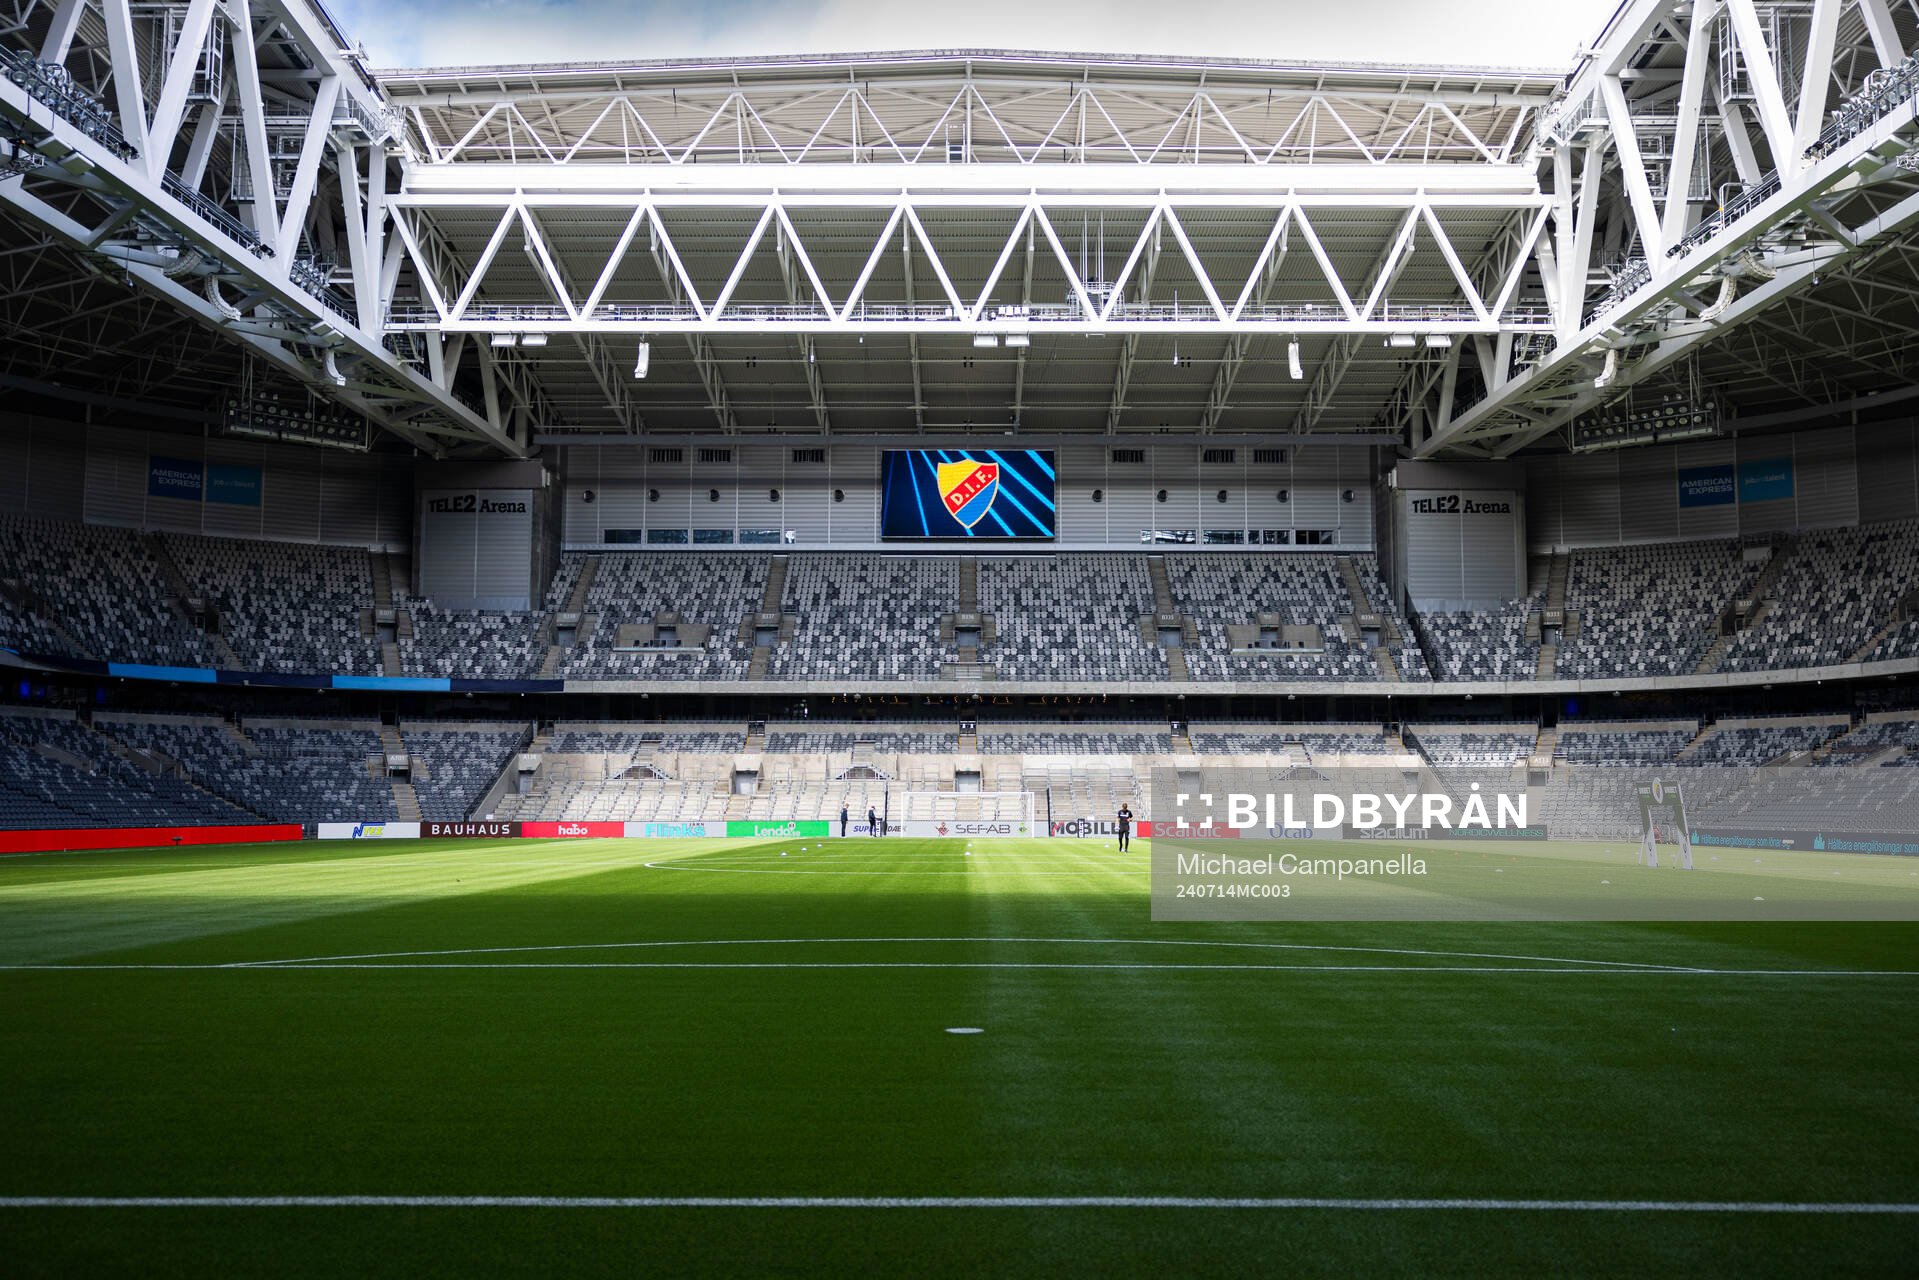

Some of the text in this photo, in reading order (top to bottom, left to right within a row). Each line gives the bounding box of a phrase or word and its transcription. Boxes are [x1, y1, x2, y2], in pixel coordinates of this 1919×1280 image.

[151, 468, 201, 480] AMERICAN
[158, 477, 201, 488] EXPRESS
[1680, 477, 1732, 488] AMERICAN
[1688, 485, 1733, 495] EXPRESS
[429, 494, 526, 513] TELE2 Arena
[1412, 495, 1511, 513] TELE2 Arena
[431, 824, 510, 835] BAUHAUS
[558, 823, 588, 835] habo
[645, 823, 705, 837] Flinks
[955, 824, 1011, 834] SEFAB
